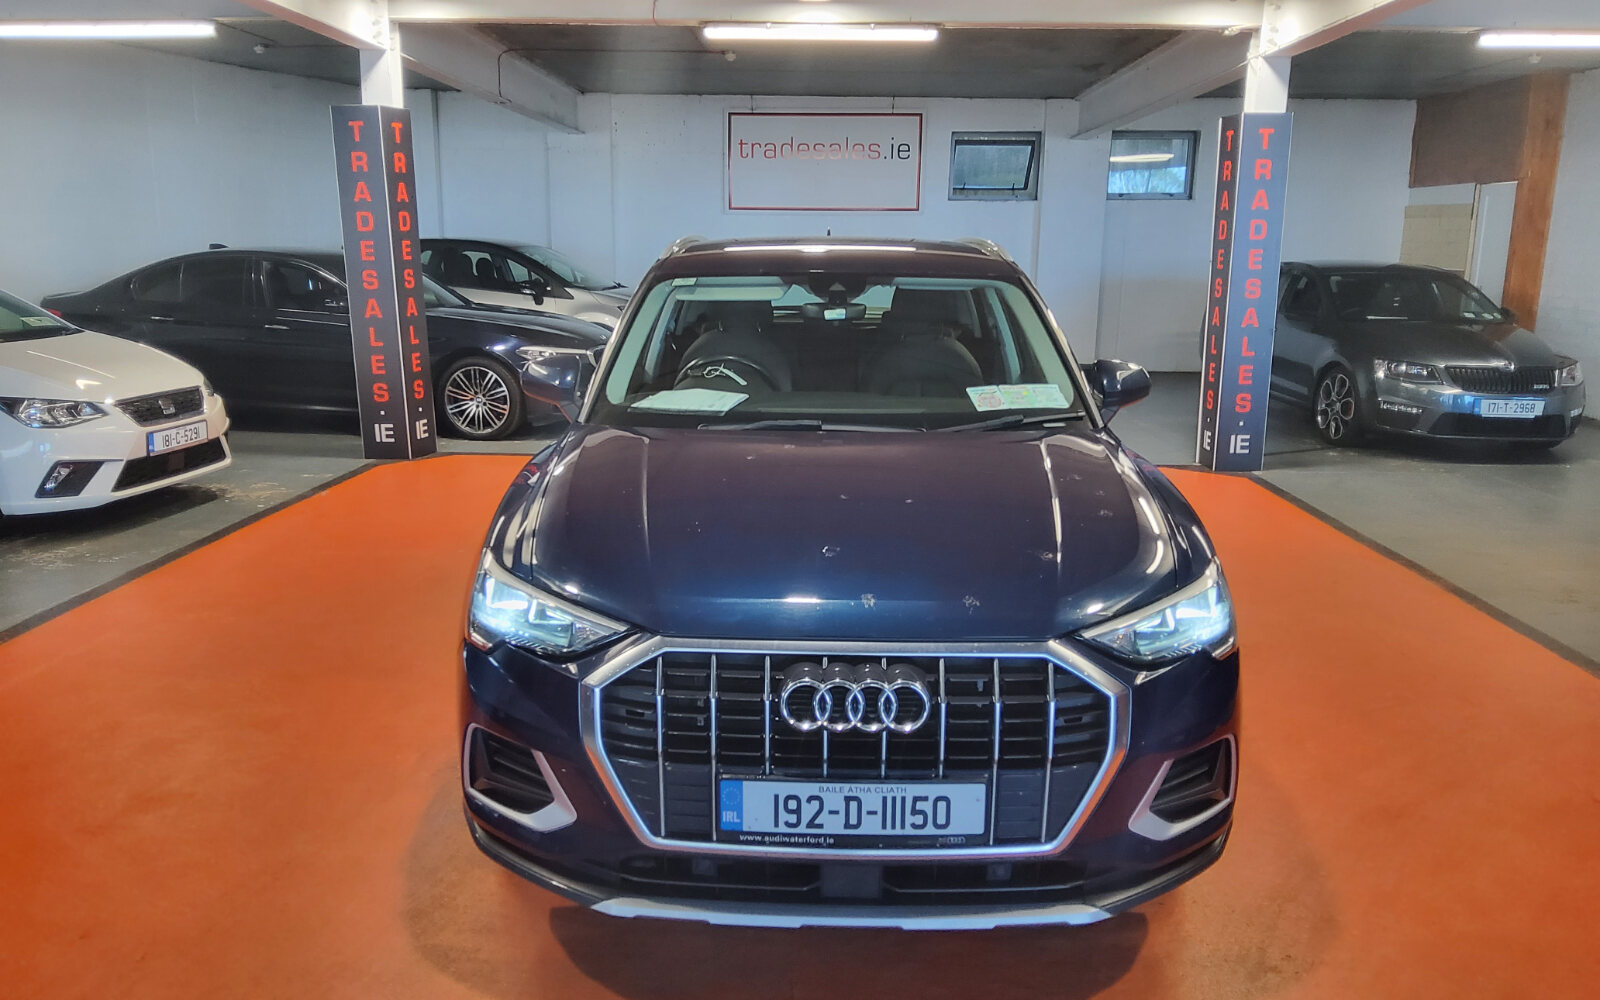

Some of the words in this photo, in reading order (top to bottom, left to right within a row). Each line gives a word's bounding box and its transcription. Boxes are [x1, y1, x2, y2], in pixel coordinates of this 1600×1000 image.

[738, 136, 911, 160] tradesales.ie
[1487, 402, 1536, 414] 171-T-2968
[162, 425, 201, 449] 181-C-5291
[818, 785, 845, 794] BAILE
[874, 786, 907, 794] CLIATH
[722, 810, 740, 823] IRL
[773, 794, 951, 831] 192-D-11150
[739, 834, 835, 845] www.audiwaterford.ie
